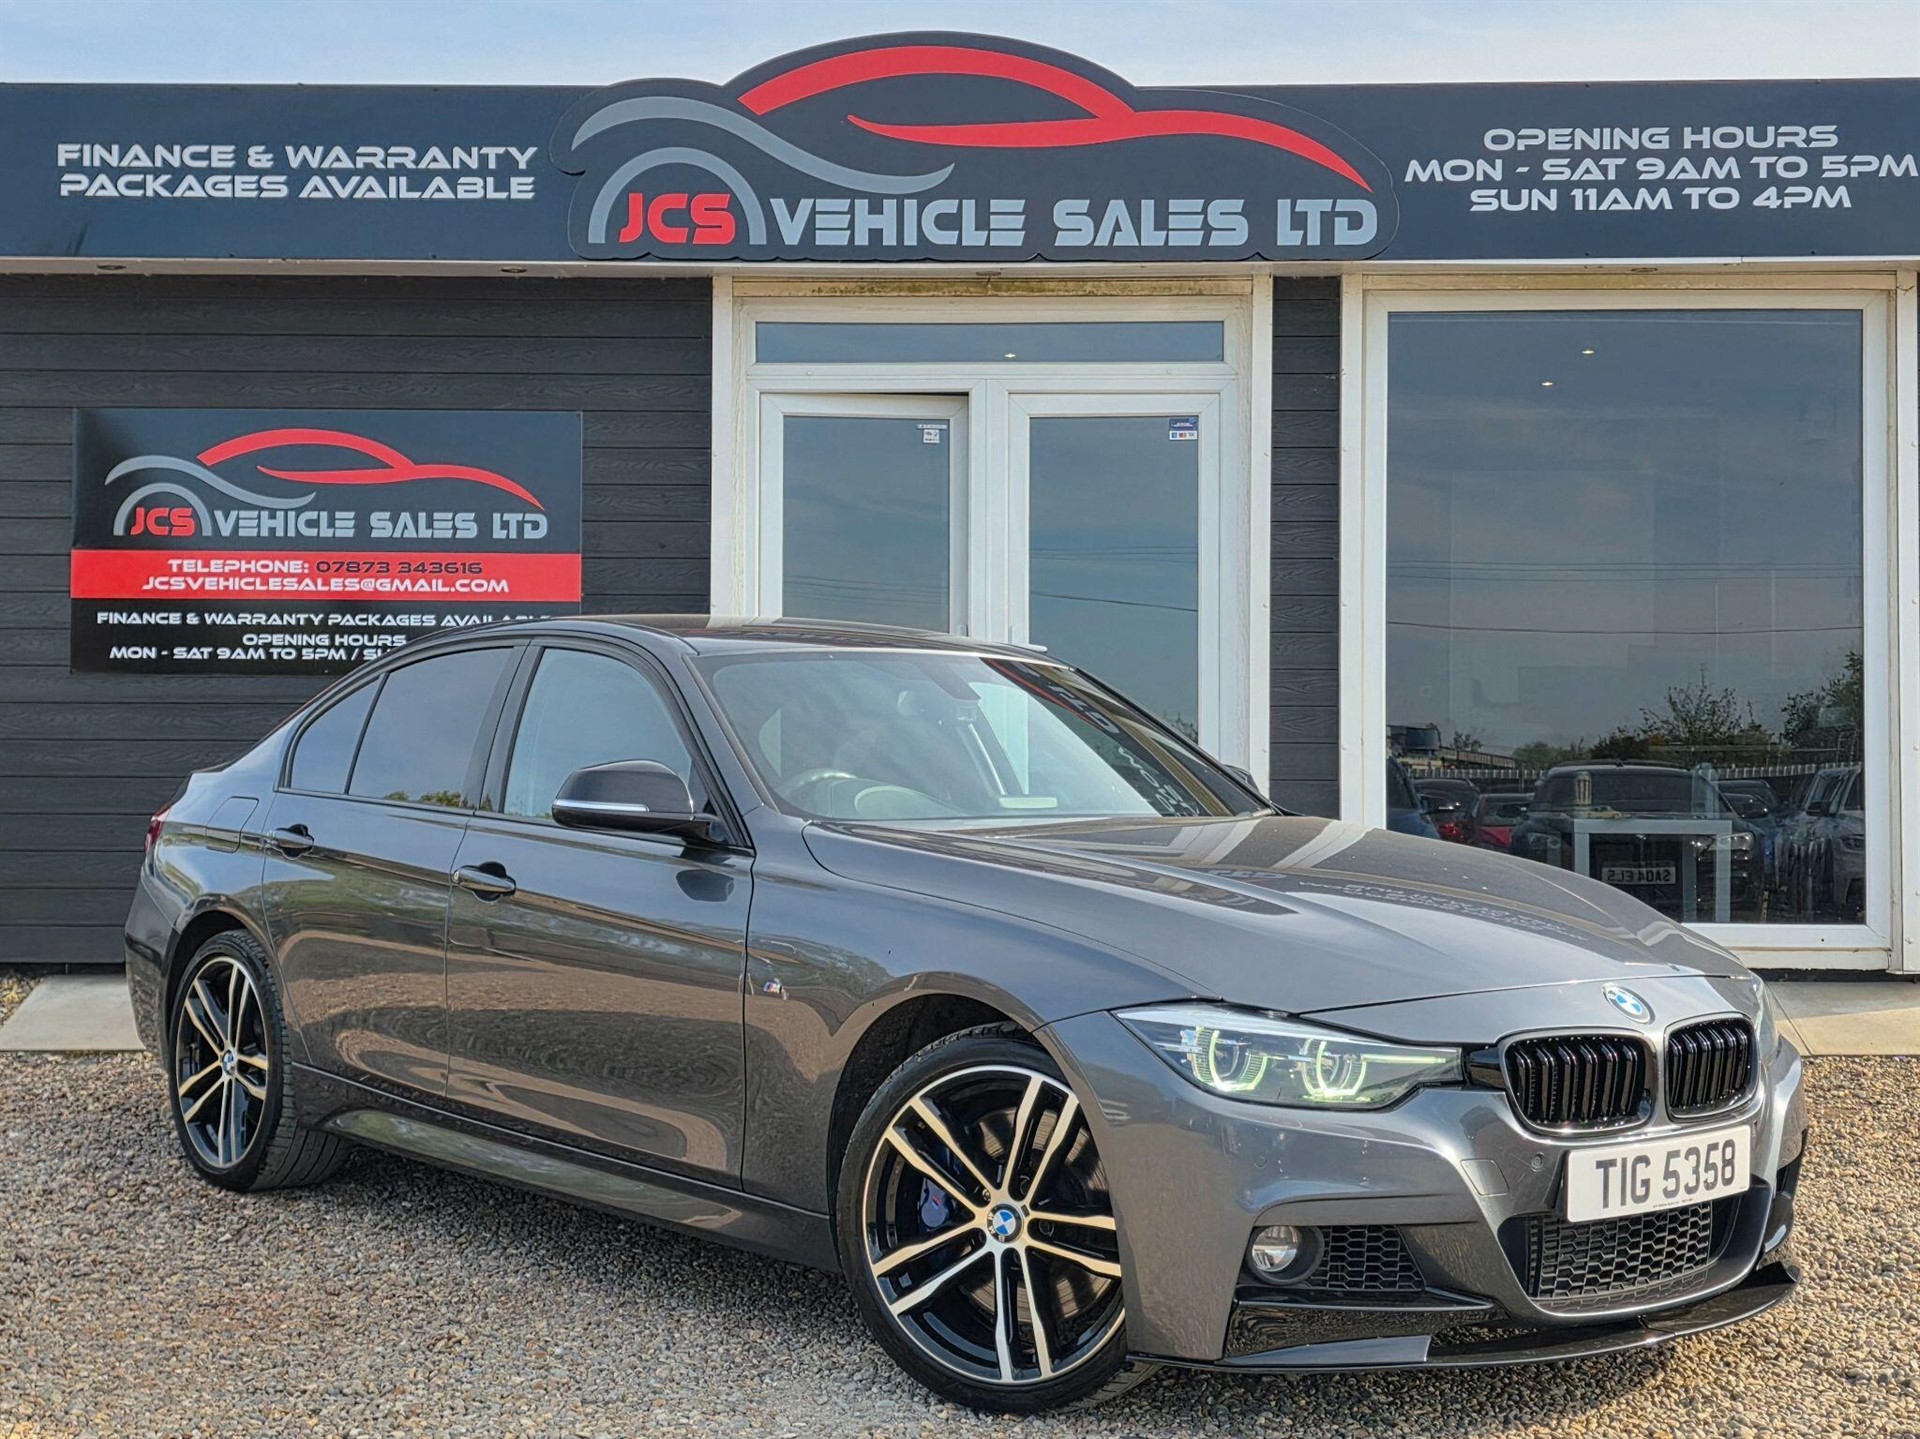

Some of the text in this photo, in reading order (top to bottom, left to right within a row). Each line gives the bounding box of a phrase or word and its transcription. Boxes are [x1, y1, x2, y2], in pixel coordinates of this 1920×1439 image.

[1483, 124, 1839, 152] OPENING HOURS
[57, 143, 538, 170] FINANCE & WARRANTY
[1404, 158, 1503, 183] MON
[1542, 157, 1627, 181] SAT
[1635, 156, 1741, 180] 9AM
[1749, 155, 1808, 179] TO
[1821, 153, 1919, 178] 5PM
[60, 173, 535, 200] PACKAGES AVAILABLE
[1469, 185, 1852, 212] SUN 11AM TO 4PM
[620, 193, 1378, 247] JCS VEHICLE SALES LTD
[130, 507, 548, 540] JCS VEHICLE SALES LTD
[167, 559, 483, 575] TELEPHONE: 07873 343616
[142, 576, 509, 593] JCSVEHICLESALES@GMAIL.COM
[96, 611, 182, 625] FINANCE
[185, 612, 200, 625] &
[204, 612, 324, 626] WARRANTY
[327, 613, 437, 627] PACKAGES
[109, 646, 157, 659] MON
[173, 646, 213, 660] SAT
[216, 647, 266, 660] 9AM
[268, 647, 297, 660] TO
[301, 647, 347, 661] 5PM
[350, 647, 359, 661] /
[242, 633, 408, 647] OPENING HOURS
[1595, 1138, 1736, 1209] TIG 5358
